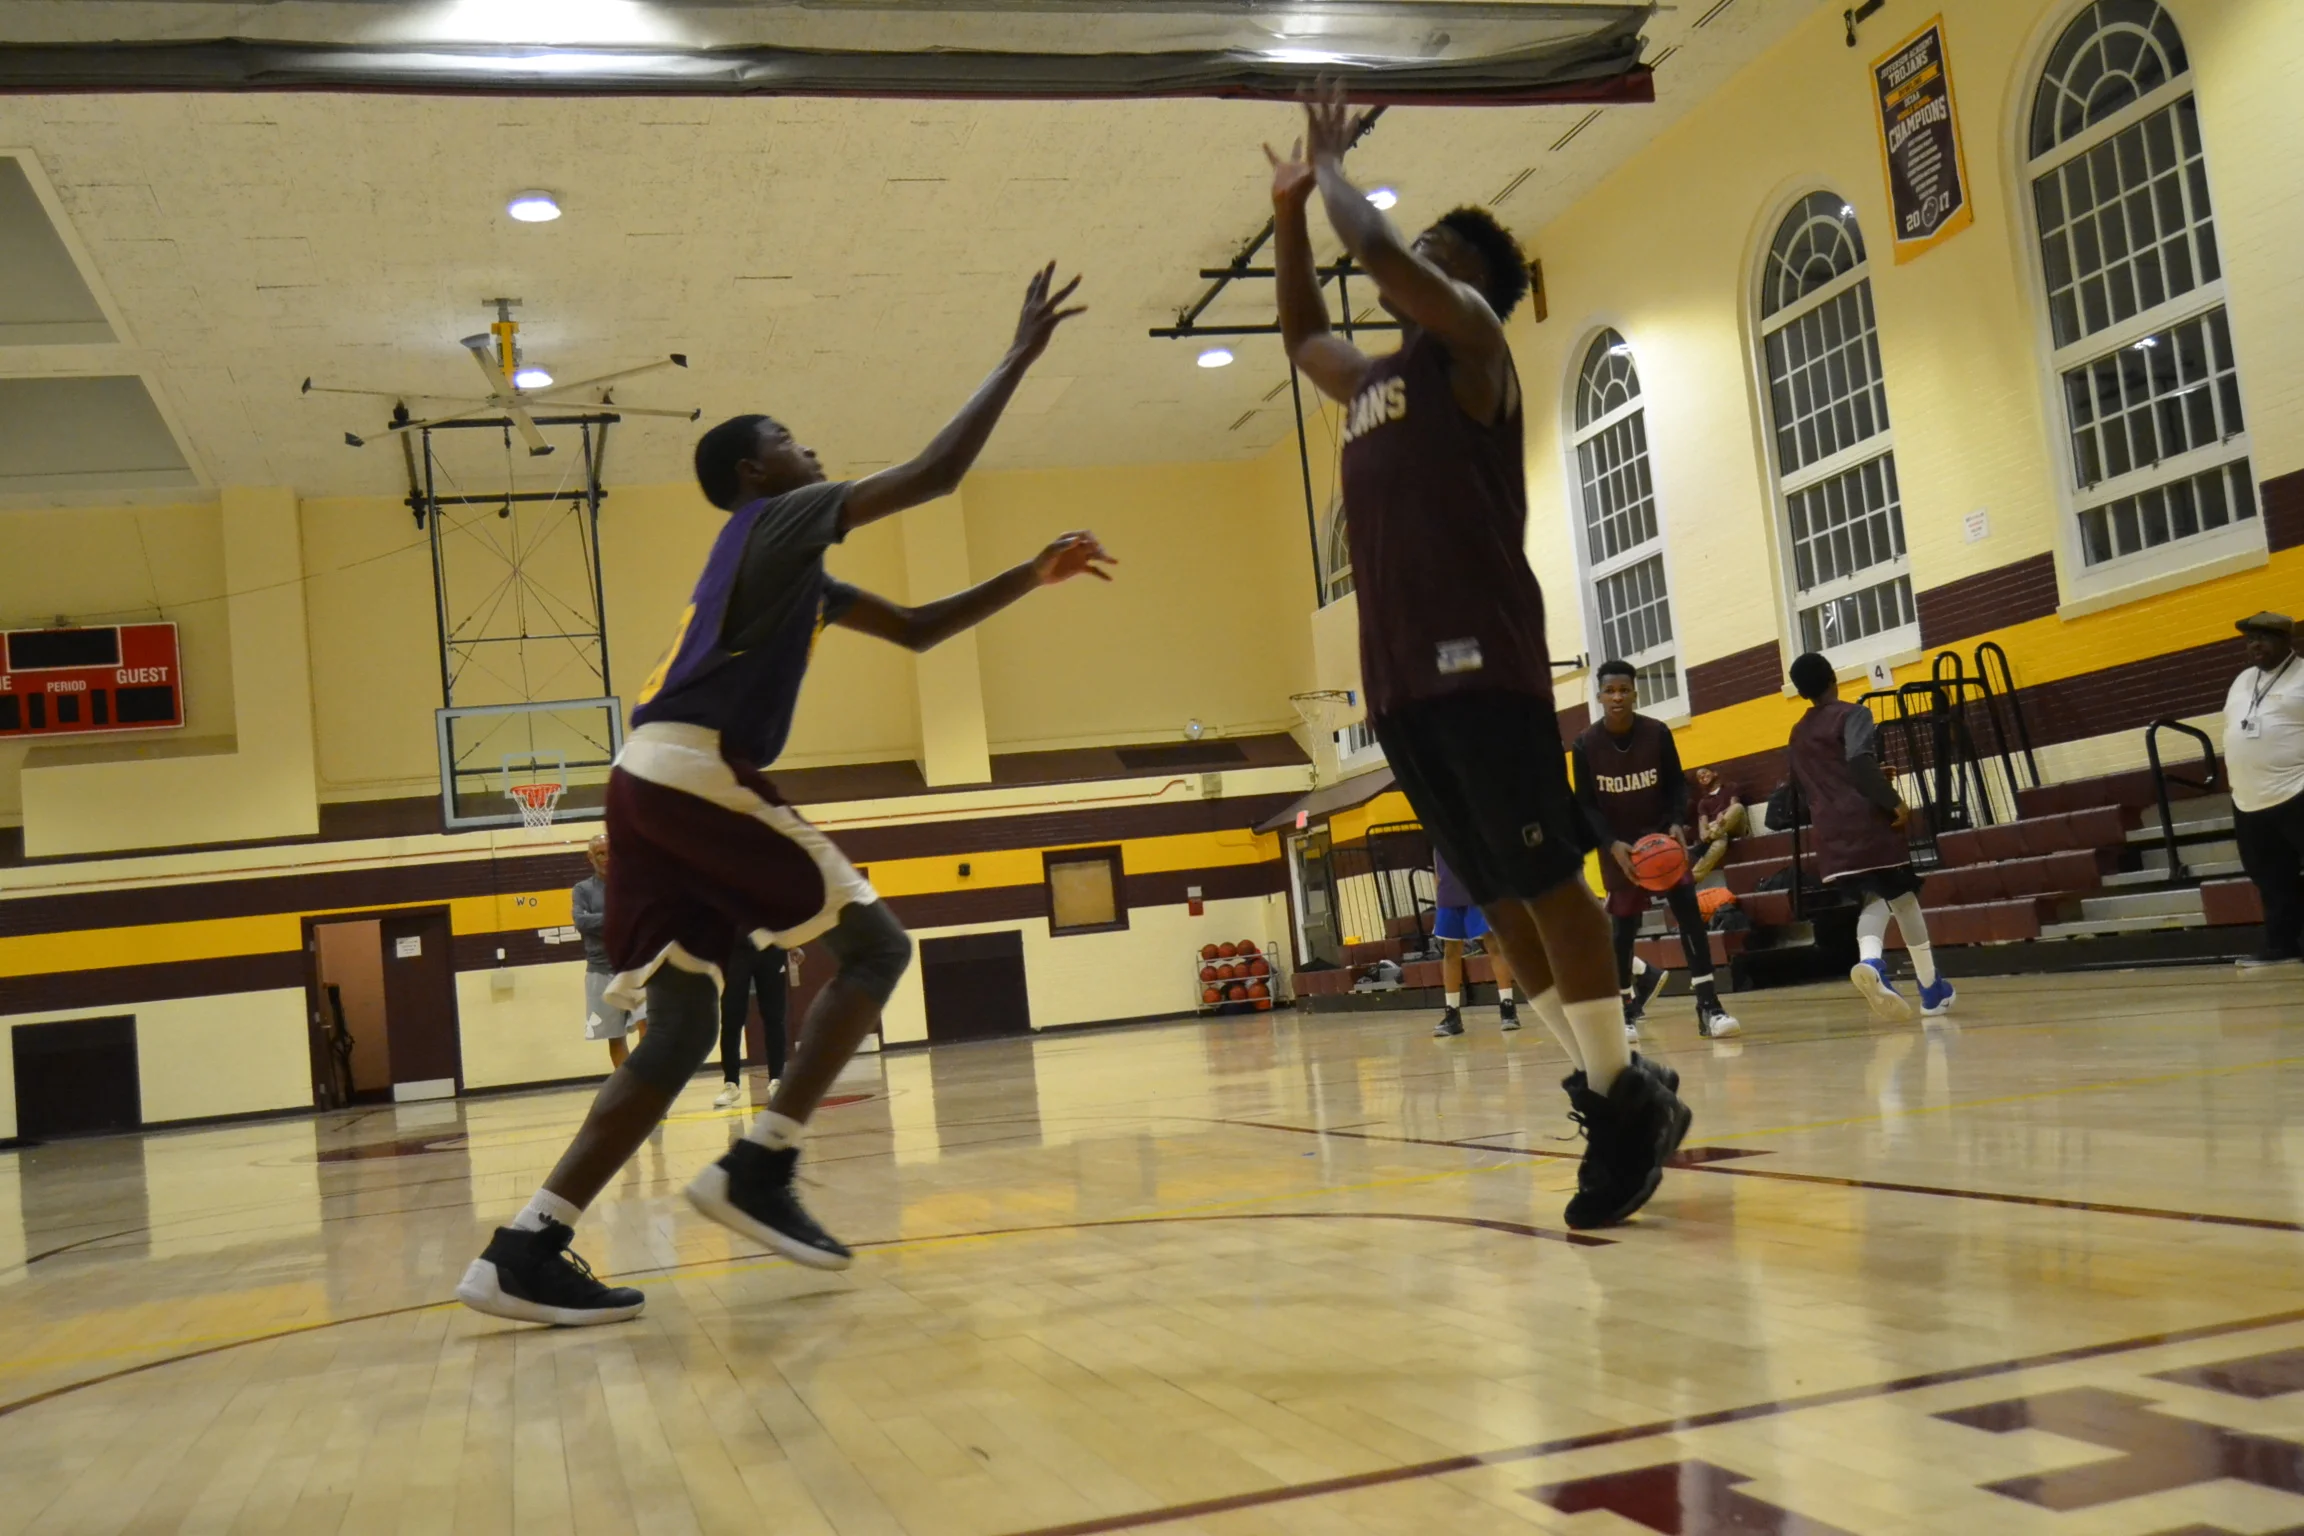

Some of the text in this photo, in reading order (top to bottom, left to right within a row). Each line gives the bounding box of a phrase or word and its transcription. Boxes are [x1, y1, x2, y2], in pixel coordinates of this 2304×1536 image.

[1888, 50, 1928, 88] TROJANS
[1888, 94, 1948, 154] CHAMPIONS
[1939, 191, 1950, 212] 17
[1906, 210, 1921, 232] 20
[116, 666, 169, 684] GUEST
[1875, 665, 1884, 680] 4
[47, 680, 87, 692] PERIOD
[1596, 768, 1657, 793] TROJANS
